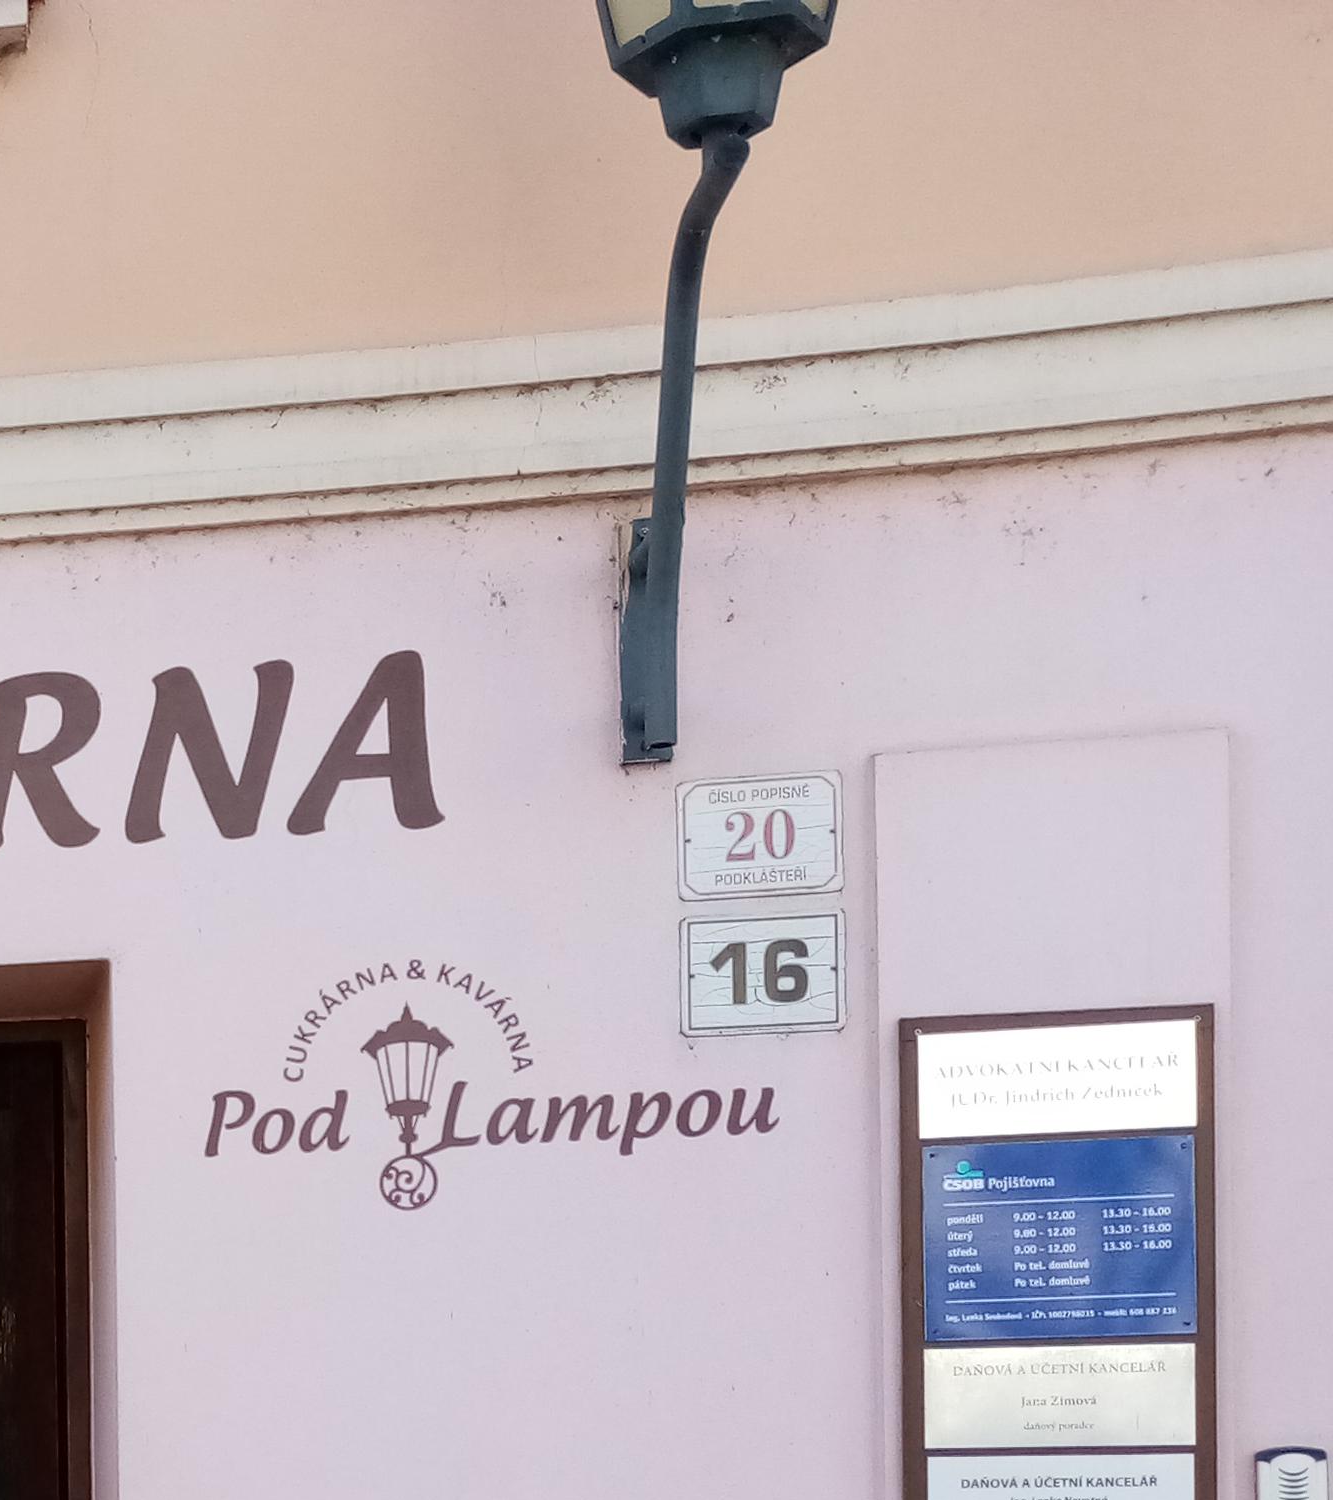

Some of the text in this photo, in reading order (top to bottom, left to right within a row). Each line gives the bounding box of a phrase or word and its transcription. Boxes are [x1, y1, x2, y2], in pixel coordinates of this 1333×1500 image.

[708, 783, 810, 804] ČÍSLO POPISNÉ
[724, 808, 796, 862] 20
[714, 866, 808, 887] PODKLÁŠTEŘÍ
[709, 938, 810, 1006] 16
[282, 959, 534, 1082] CUKRÁRNA & KAVÁRNA
[204, 1080, 779, 1157] Pod Lampou
[987, 1176, 1055, 1192] Pojišťovna
[947, 1213, 984, 1226] pondělí
[1046, 1210, 1075, 1221] 12.00
[947, 1230, 973, 1242] úterý
[947, 1247, 978, 1257] středa
[1016, 1365, 1026, 1375] A
[961, 1475, 1158, 1489] DAŇOVÁ A ÚČETNÍ KANCELÁŘ
